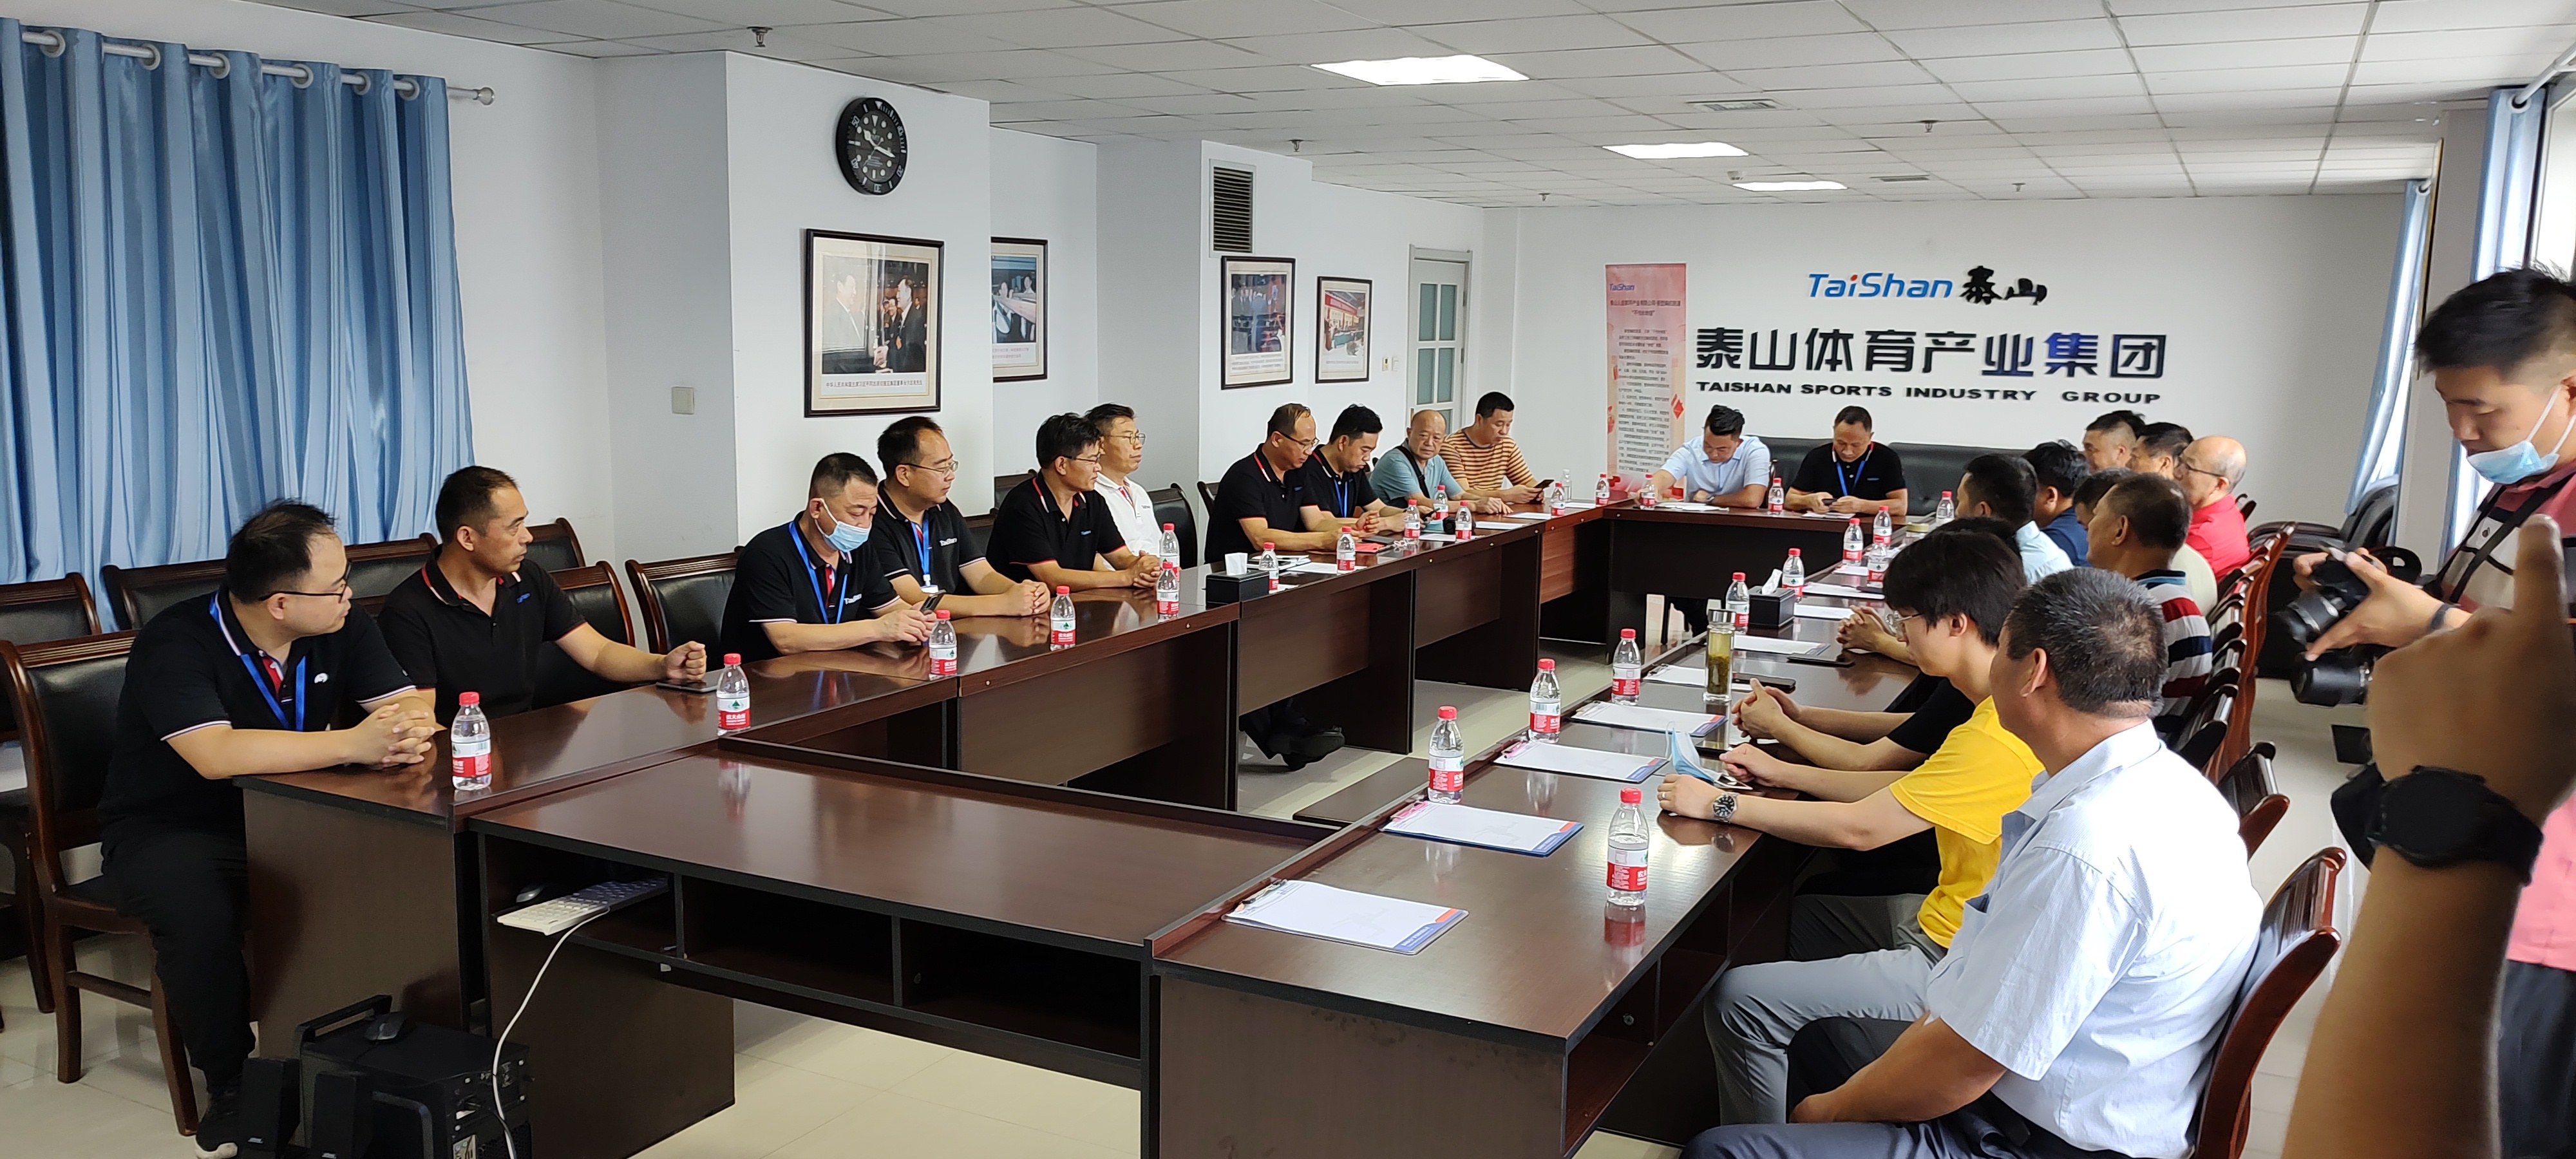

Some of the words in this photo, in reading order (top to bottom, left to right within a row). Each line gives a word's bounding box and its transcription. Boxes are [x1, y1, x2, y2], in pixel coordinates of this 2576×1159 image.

[1808, 272, 1953, 298] TaiShan
[1959, 265, 2048, 306] 泰山
[1696, 327, 2167, 379] 泰山体育产业集团
[1696, 381, 1792, 394] TAISHAN
[1801, 384, 1892, 397] SPORTS
[1906, 387, 2038, 401] INDUSTRY
[2061, 391, 2161, 405] GROUP
